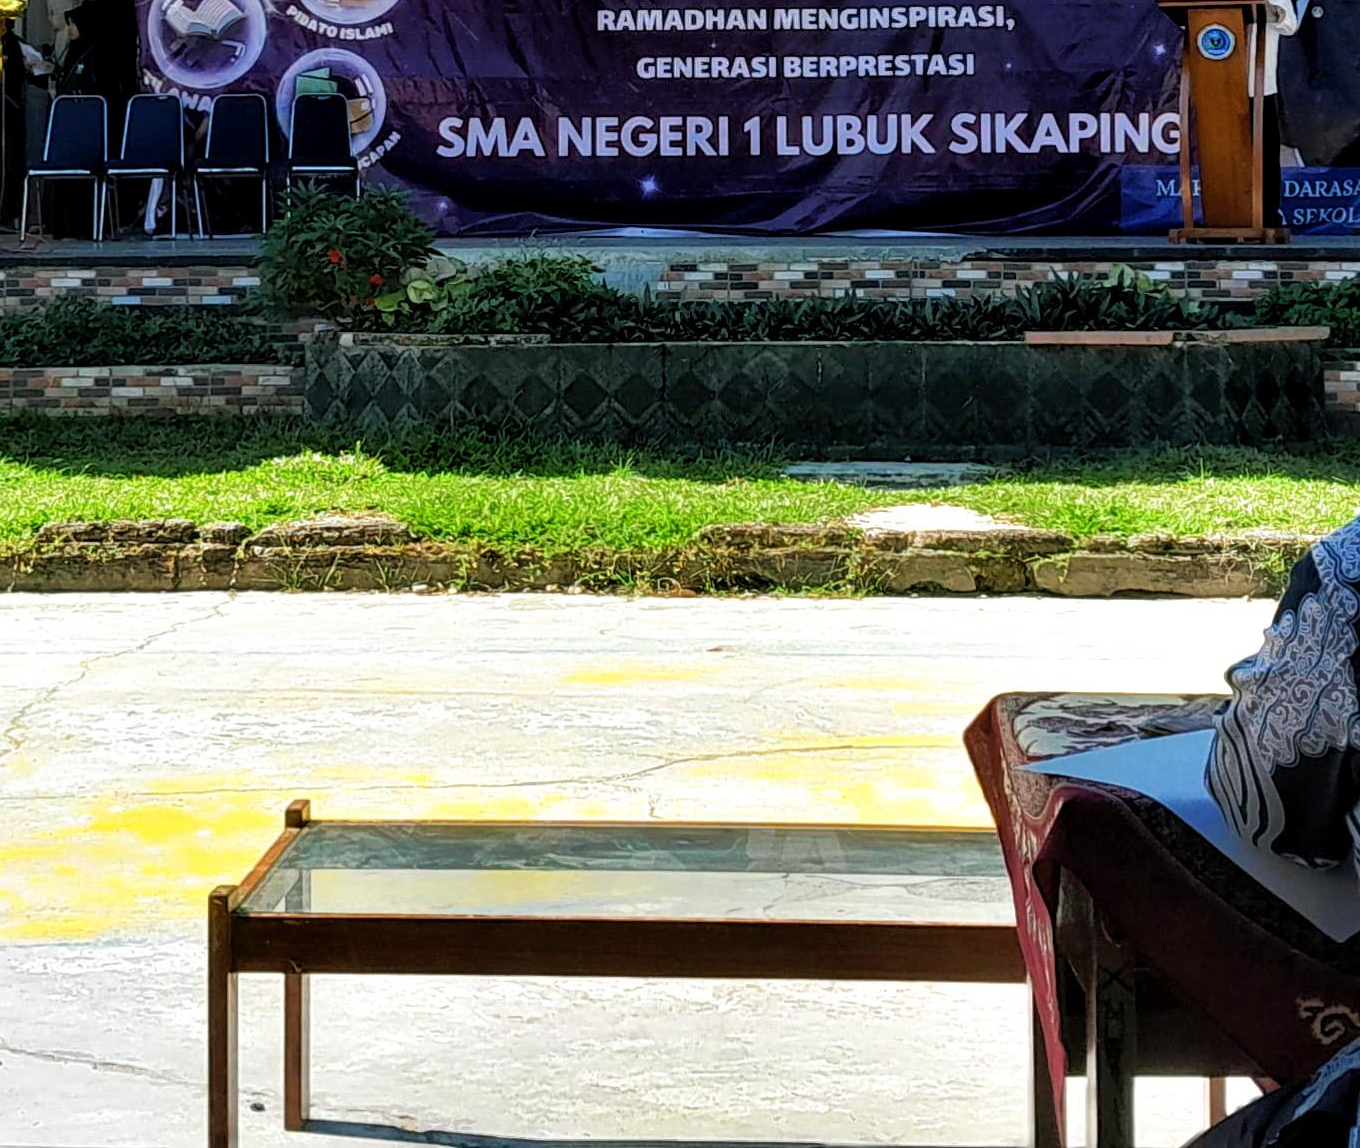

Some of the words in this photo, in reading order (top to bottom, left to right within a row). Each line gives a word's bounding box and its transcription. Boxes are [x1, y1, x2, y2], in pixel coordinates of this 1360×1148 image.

[286, 5, 338, 38] PIDATO
[339, 22, 394, 40] ISLAMI
[596, 8, 768, 31] RAMADHAN
[773, 5, 1016, 31] MENGINSPIRASI,
[637, 57, 777, 79] GENERASI
[782, 53, 976, 78] BERPRESTASI
[357, 130, 401, 171] CAPAN
[436, 116, 545, 158] SMA
[557, 115, 729, 157] NEGERI
[743, 115, 761, 156] 1
[775, 114, 937, 156] LUBUK
[947, 112, 1181, 155] SIKAPING
